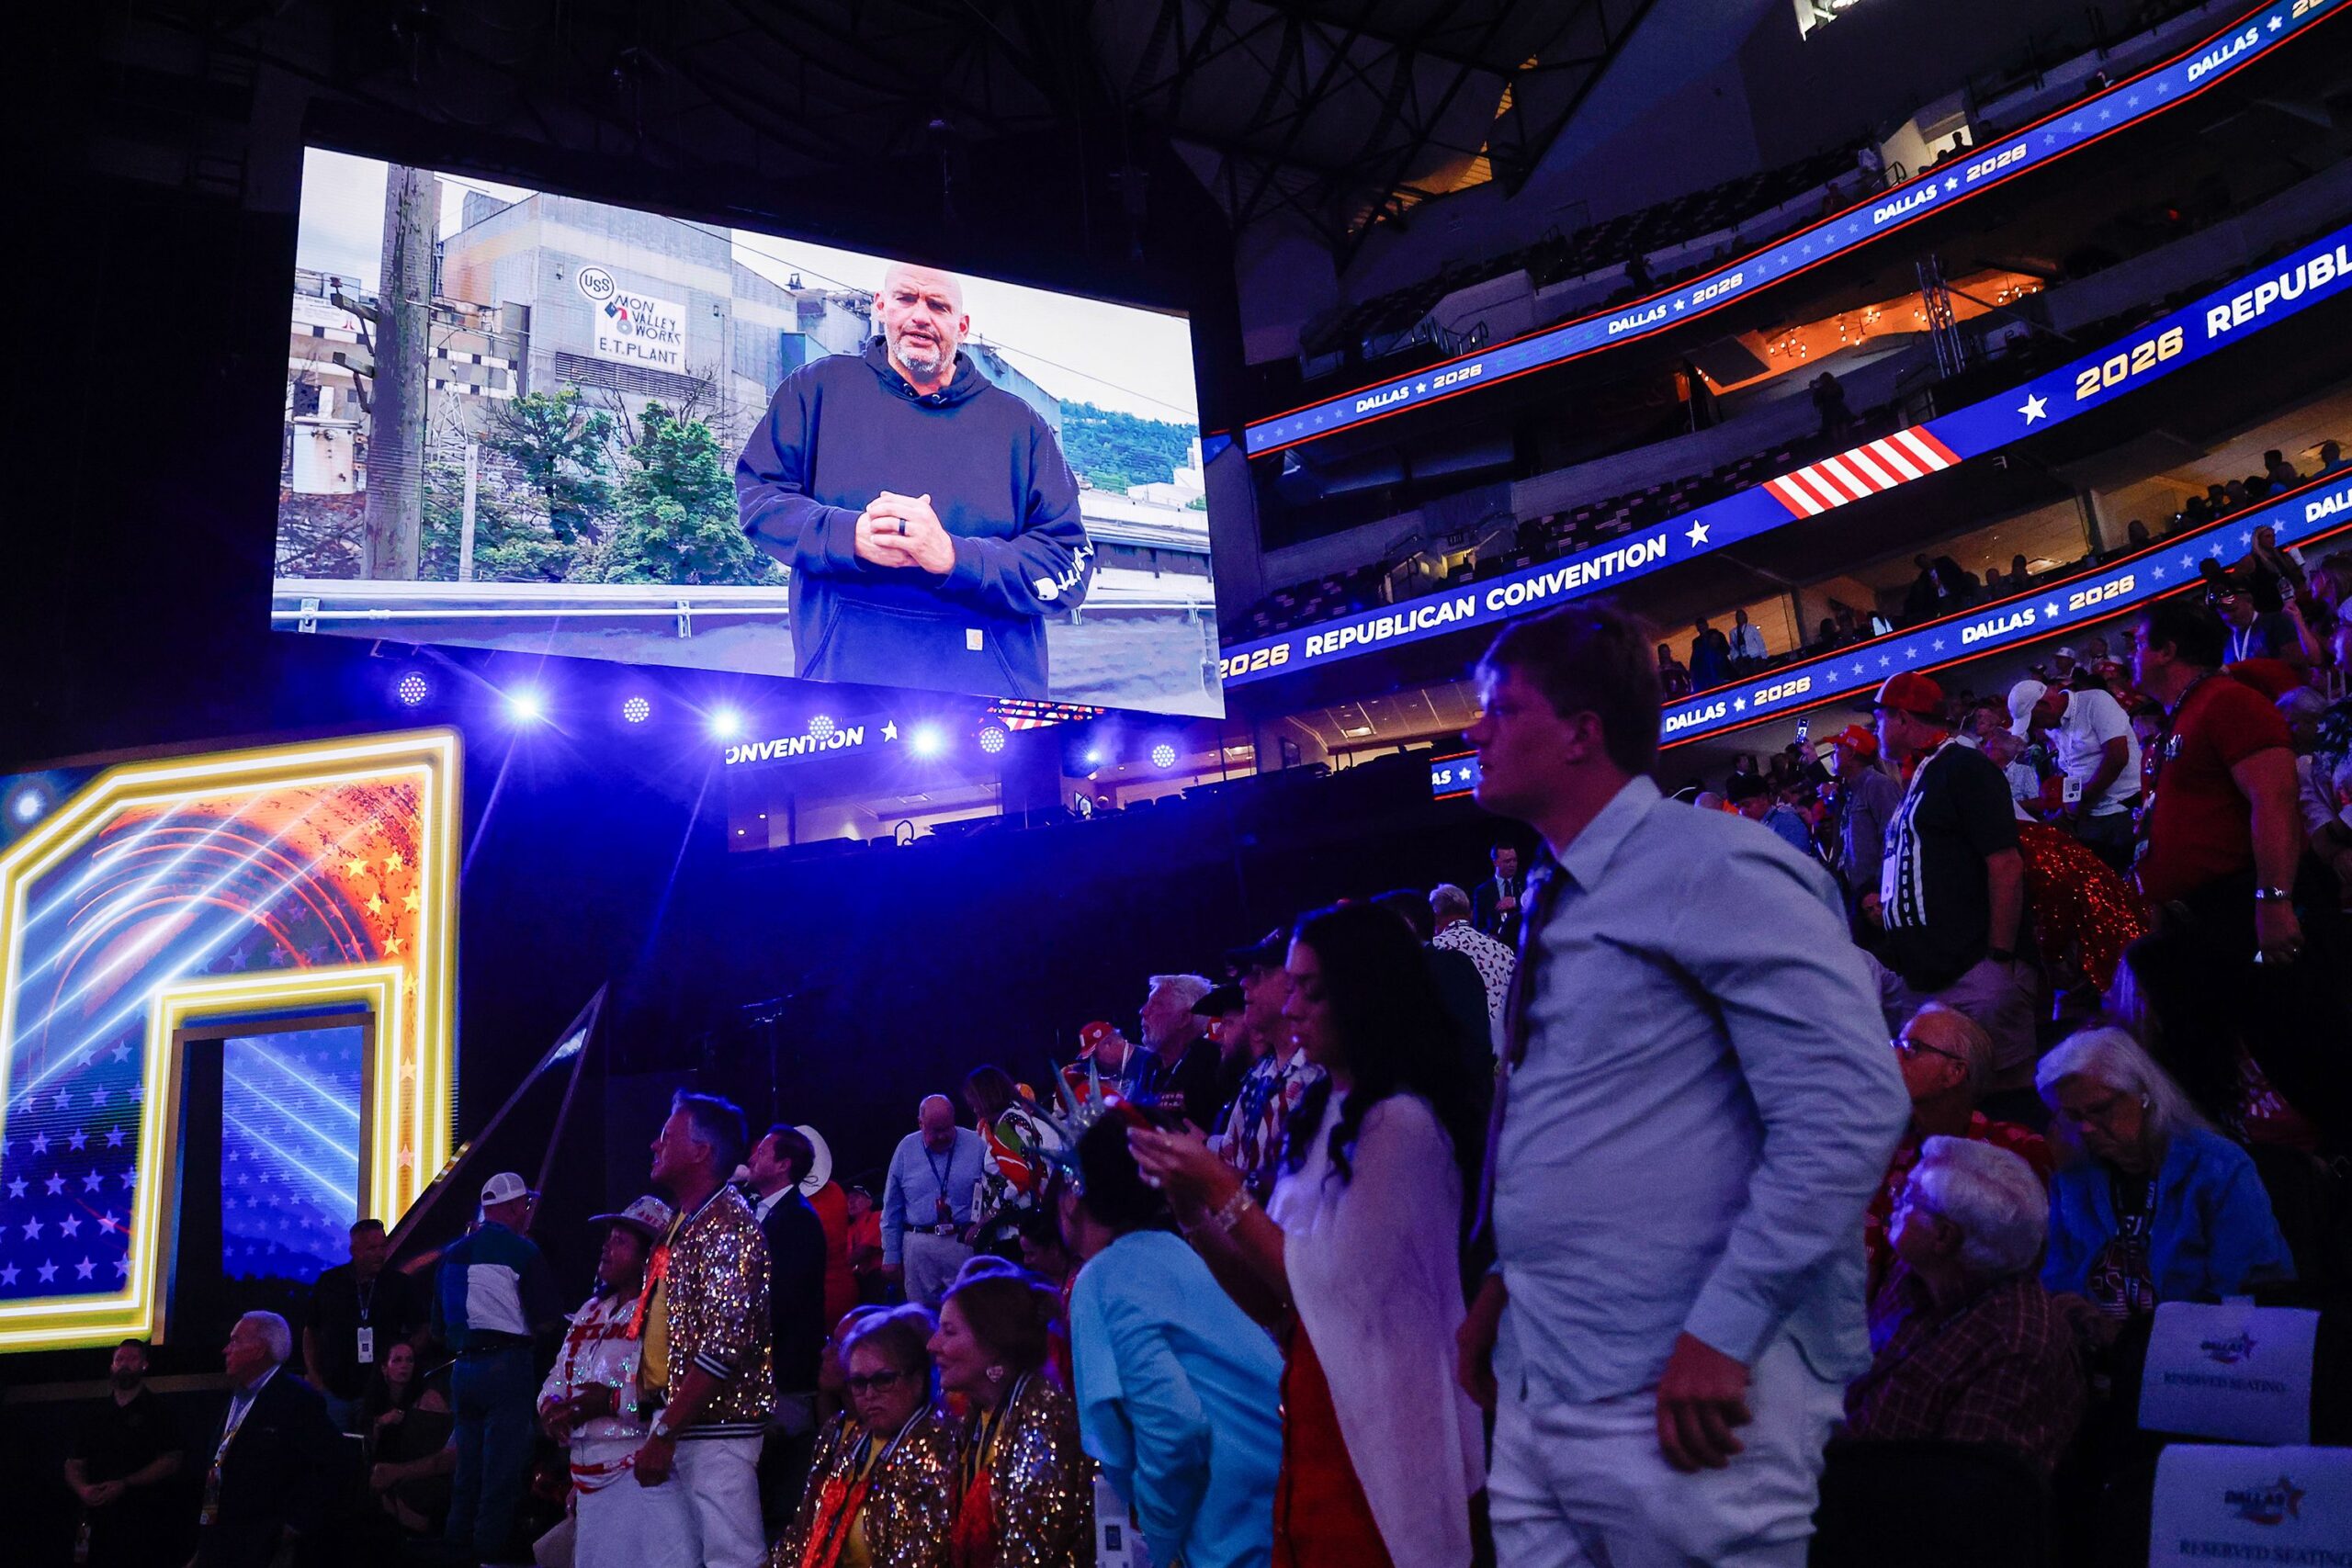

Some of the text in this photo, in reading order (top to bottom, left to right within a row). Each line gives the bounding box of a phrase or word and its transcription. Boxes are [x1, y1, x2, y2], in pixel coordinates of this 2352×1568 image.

[2188, 27, 2259, 82] DALLAS
[1873, 143, 2028, 225] DALLAS 2026
[584, 275, 610, 293] USS
[615, 295, 654, 313] MON
[1608, 272, 1744, 335] DALLAS 2026
[632, 310, 676, 332] VALLEY
[636, 325, 682, 345] WORKS
[2075, 244, 2352, 401] 2026 REPUBL
[1355, 363, 1483, 413] DALLAS 2026
[1219, 534, 1667, 680] 2026 REPUBLICAN CONVENTION
[1962, 574, 2135, 645] DALLAS 2026
[1666, 676, 1812, 733] DALLAS 2026
[1431, 770, 1452, 785] AS
